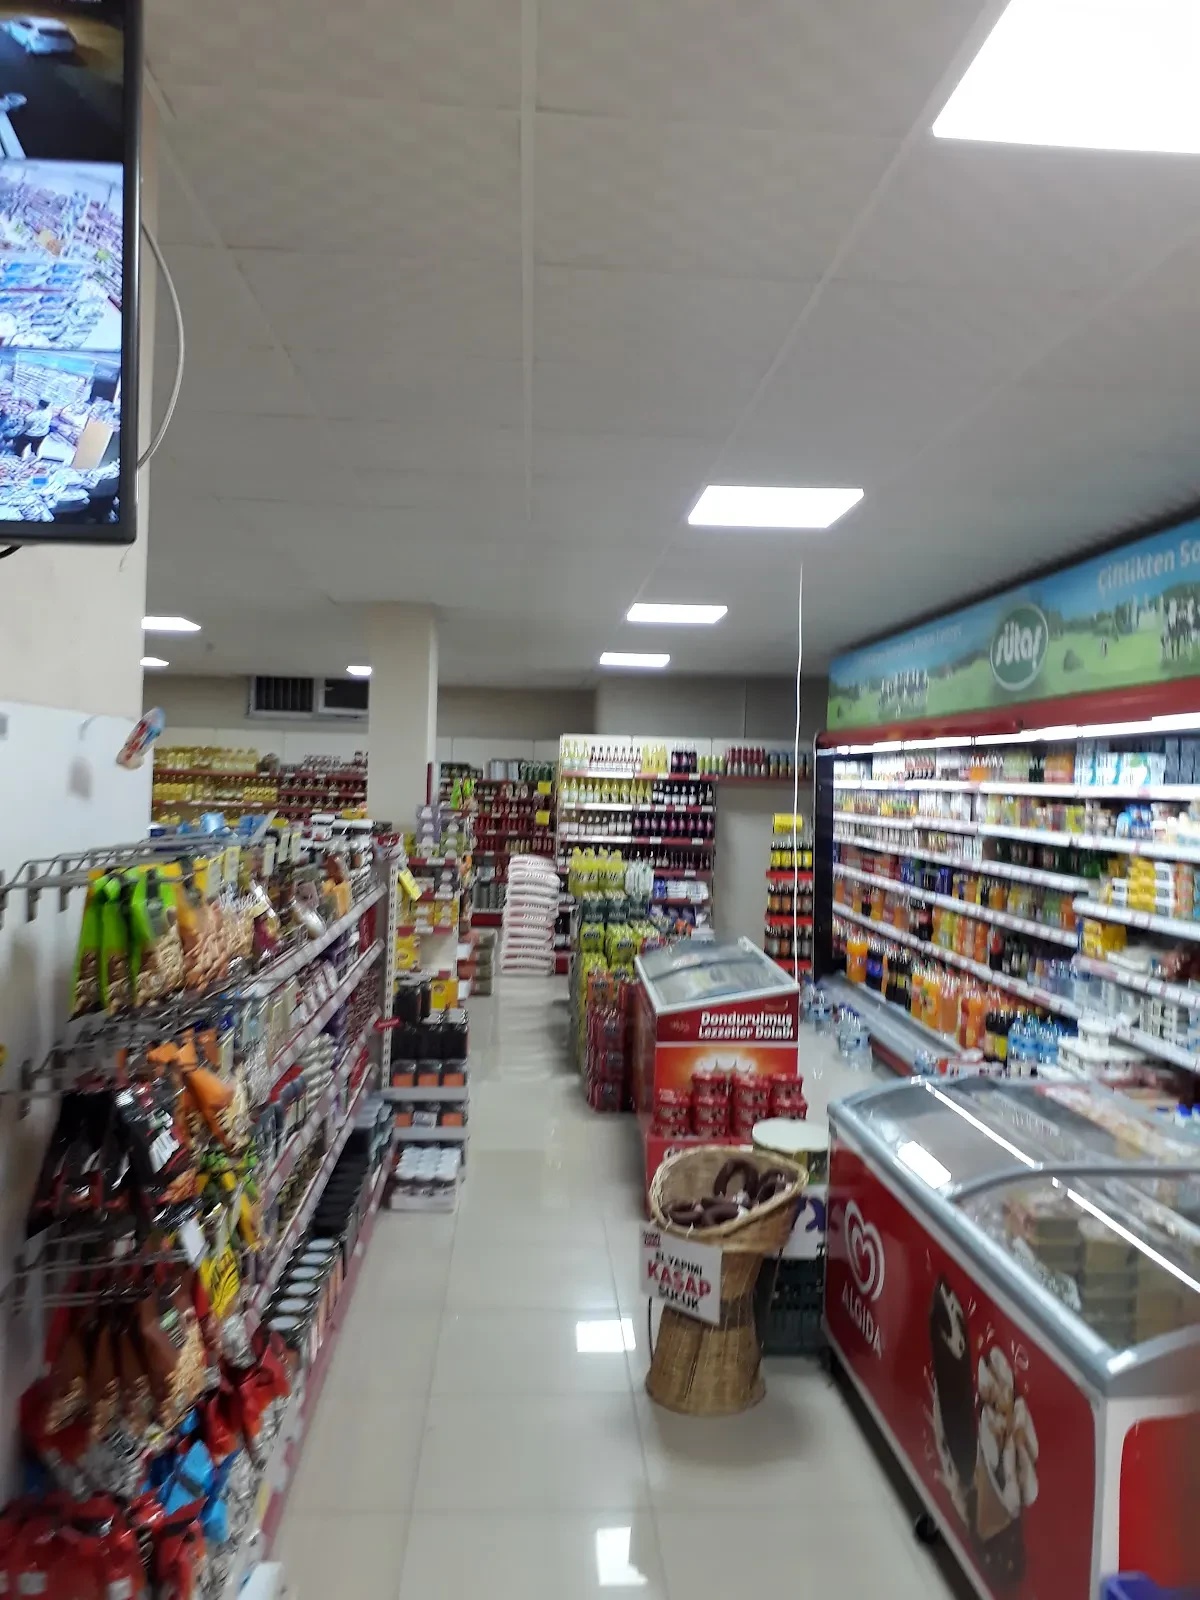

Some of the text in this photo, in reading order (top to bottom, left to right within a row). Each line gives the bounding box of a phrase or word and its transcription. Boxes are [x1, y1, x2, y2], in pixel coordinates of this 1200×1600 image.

[698, 1025, 754, 1039] Lezzetler
[647, 1260, 712, 1297] KASAP
[841, 1279, 882, 1361] ALGIDA
